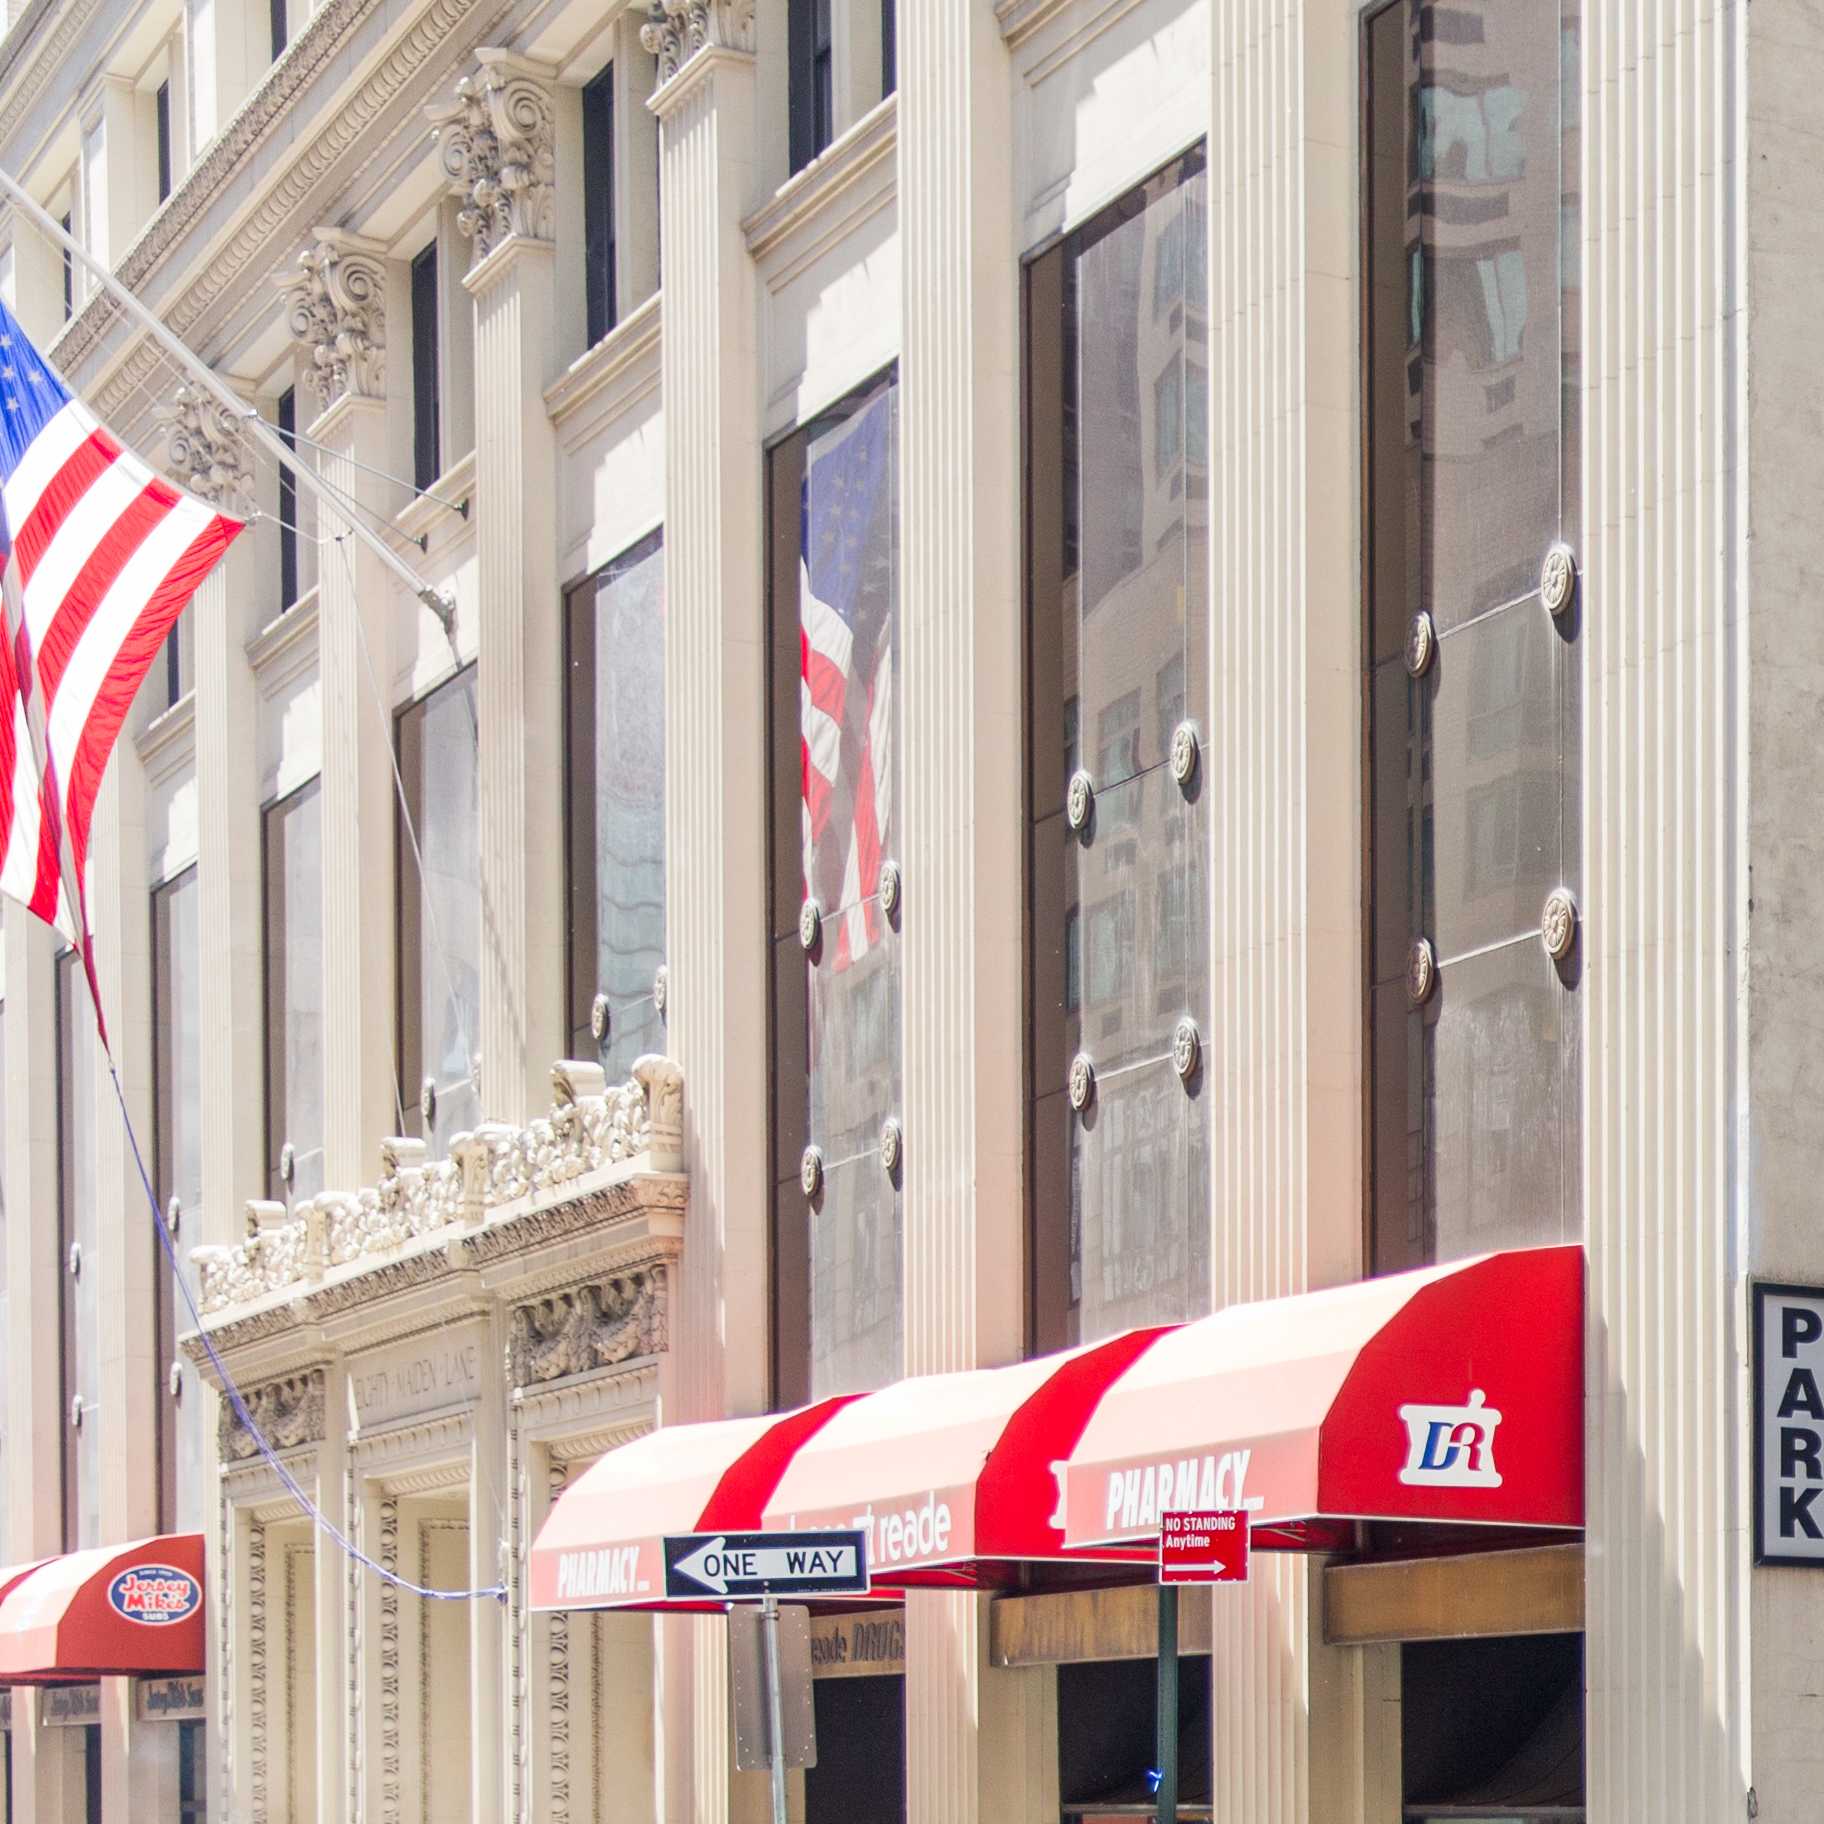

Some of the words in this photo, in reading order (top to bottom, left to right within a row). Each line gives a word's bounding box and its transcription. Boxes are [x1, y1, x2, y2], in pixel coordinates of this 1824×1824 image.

[1106, 1449, 1252, 1531] PHARMACY
[879, 1490, 952, 1563] reade
[1165, 1516, 1181, 1532] NO
[1183, 1516, 1236, 1531] STANDING
[1165, 1534, 1211, 1550] Anytime
[557, 1545, 640, 1600] PHARMACY
[703, 1552, 758, 1578] ONE
[786, 1550, 844, 1575] WAY
[119, 1573, 190, 1596] Jersey
[811, 1626, 848, 1665] eade
